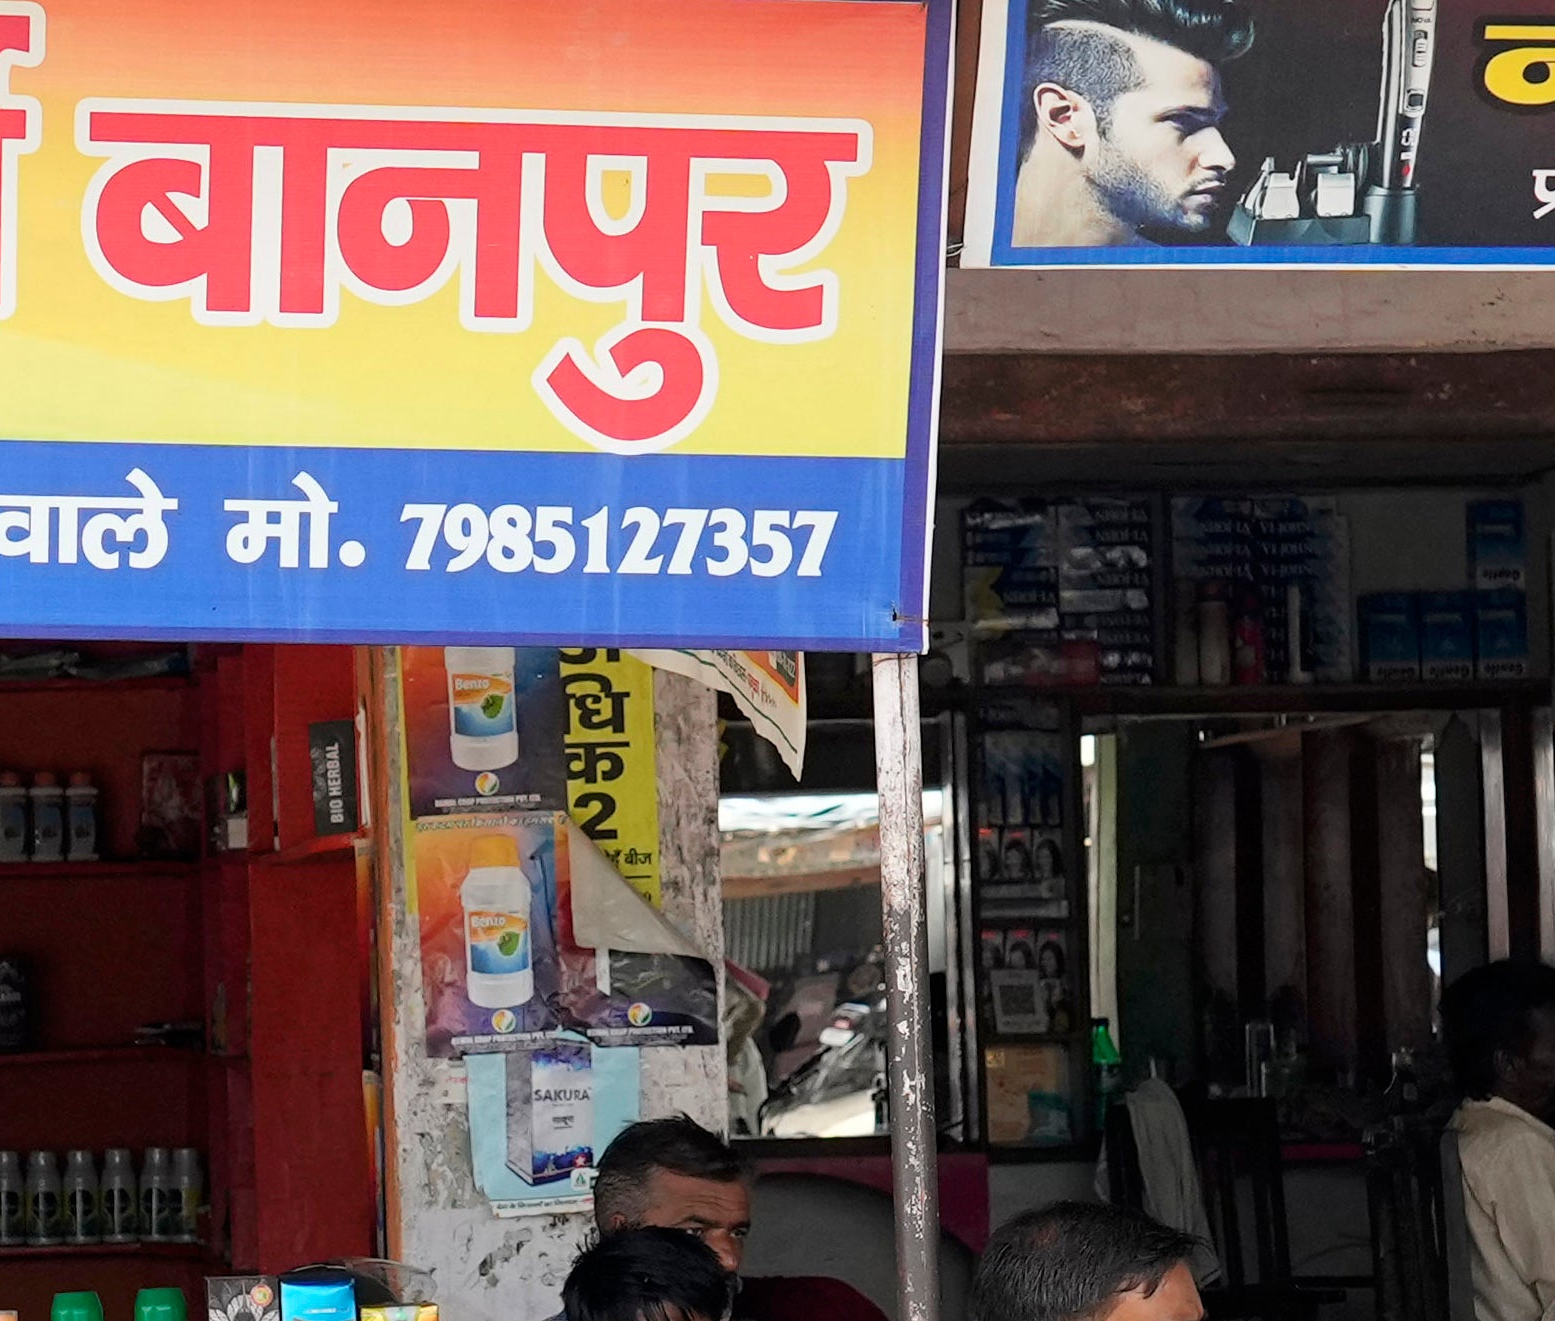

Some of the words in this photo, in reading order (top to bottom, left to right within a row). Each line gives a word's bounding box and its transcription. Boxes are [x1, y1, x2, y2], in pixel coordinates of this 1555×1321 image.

[91, 110, 858, 439] बानपुर
[225, 472, 365, 569] मो.
[401, 505, 838, 579] 7985127357
[326, 742, 342, 795] HERBAL
[330, 800, 344, 823] BIO
[574, 792, 617, 840] 2
[625, 848, 651, 865] बीज
[534, 1088, 590, 1102] SAKURA
